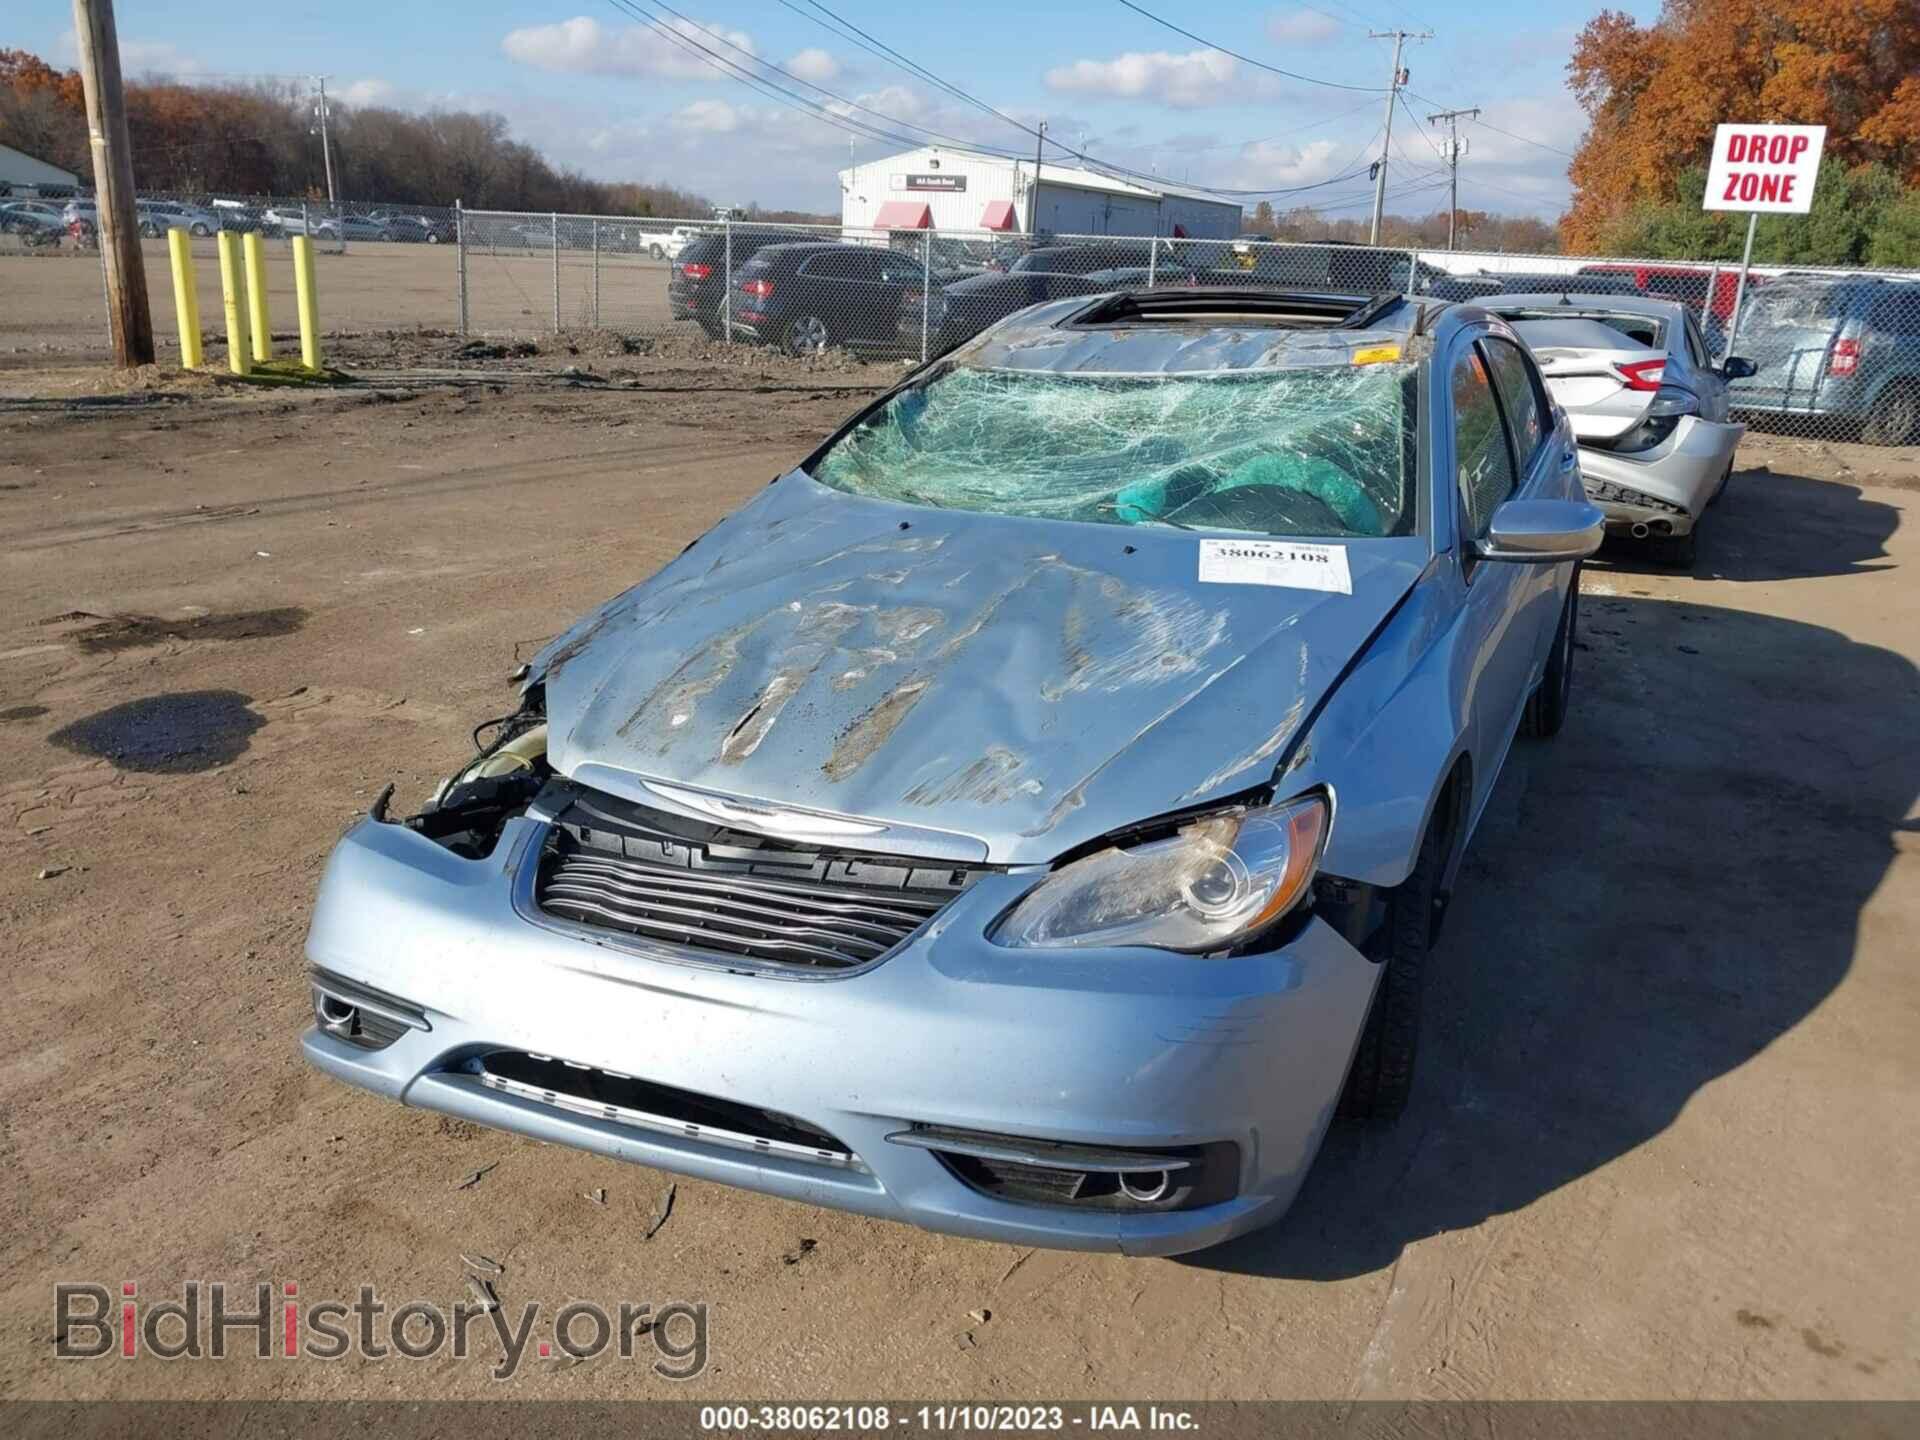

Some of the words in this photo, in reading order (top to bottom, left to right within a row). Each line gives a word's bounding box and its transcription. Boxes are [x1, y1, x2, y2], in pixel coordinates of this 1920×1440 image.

[1727, 133, 1809, 164] DROP
[1723, 172, 1797, 203] ZONE
[1217, 548, 1329, 563] 38062108
